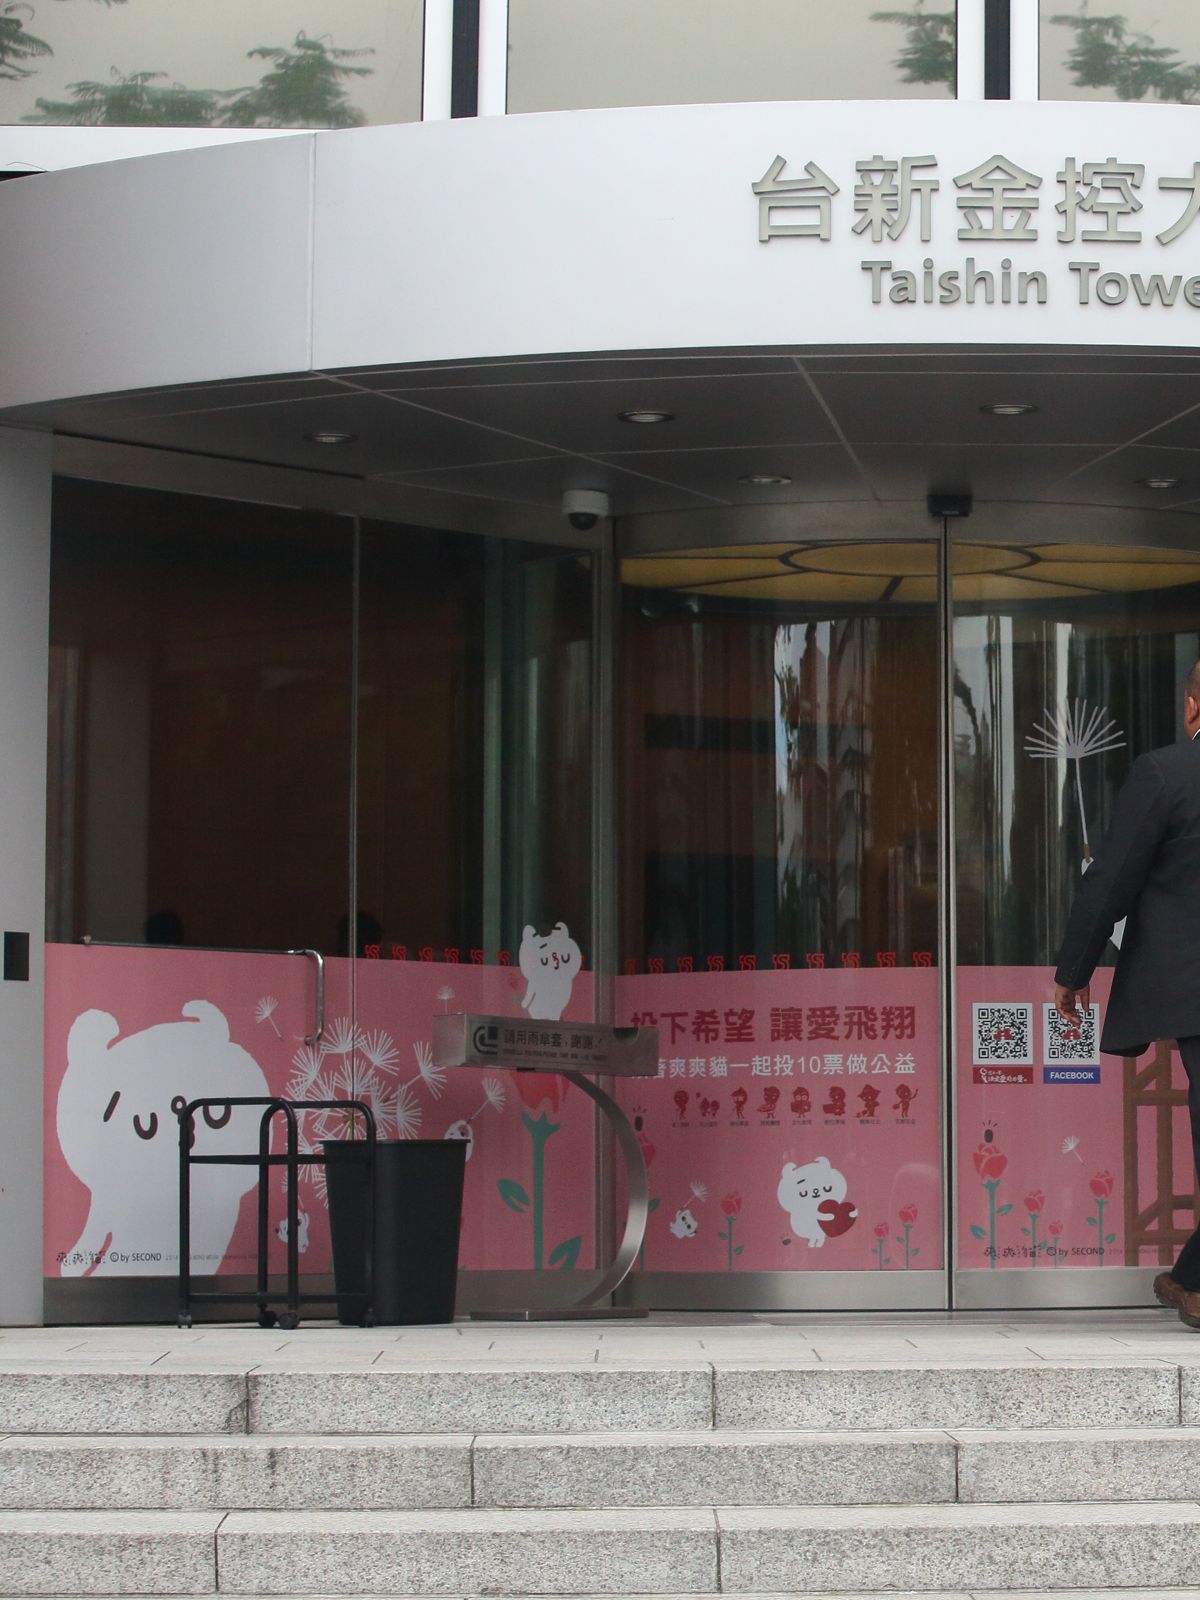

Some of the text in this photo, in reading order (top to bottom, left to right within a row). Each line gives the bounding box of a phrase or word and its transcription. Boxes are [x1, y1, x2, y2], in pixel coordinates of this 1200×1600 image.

[861, 257, 1048, 306] Taishin
[771, 1006, 916, 1042] 讓愛飛翔
[1050, 1071, 1094, 1080] FACEBOOK
[1071, 1247, 1105, 1256] SECOND
[132, 1252, 162, 1262] SECOND
